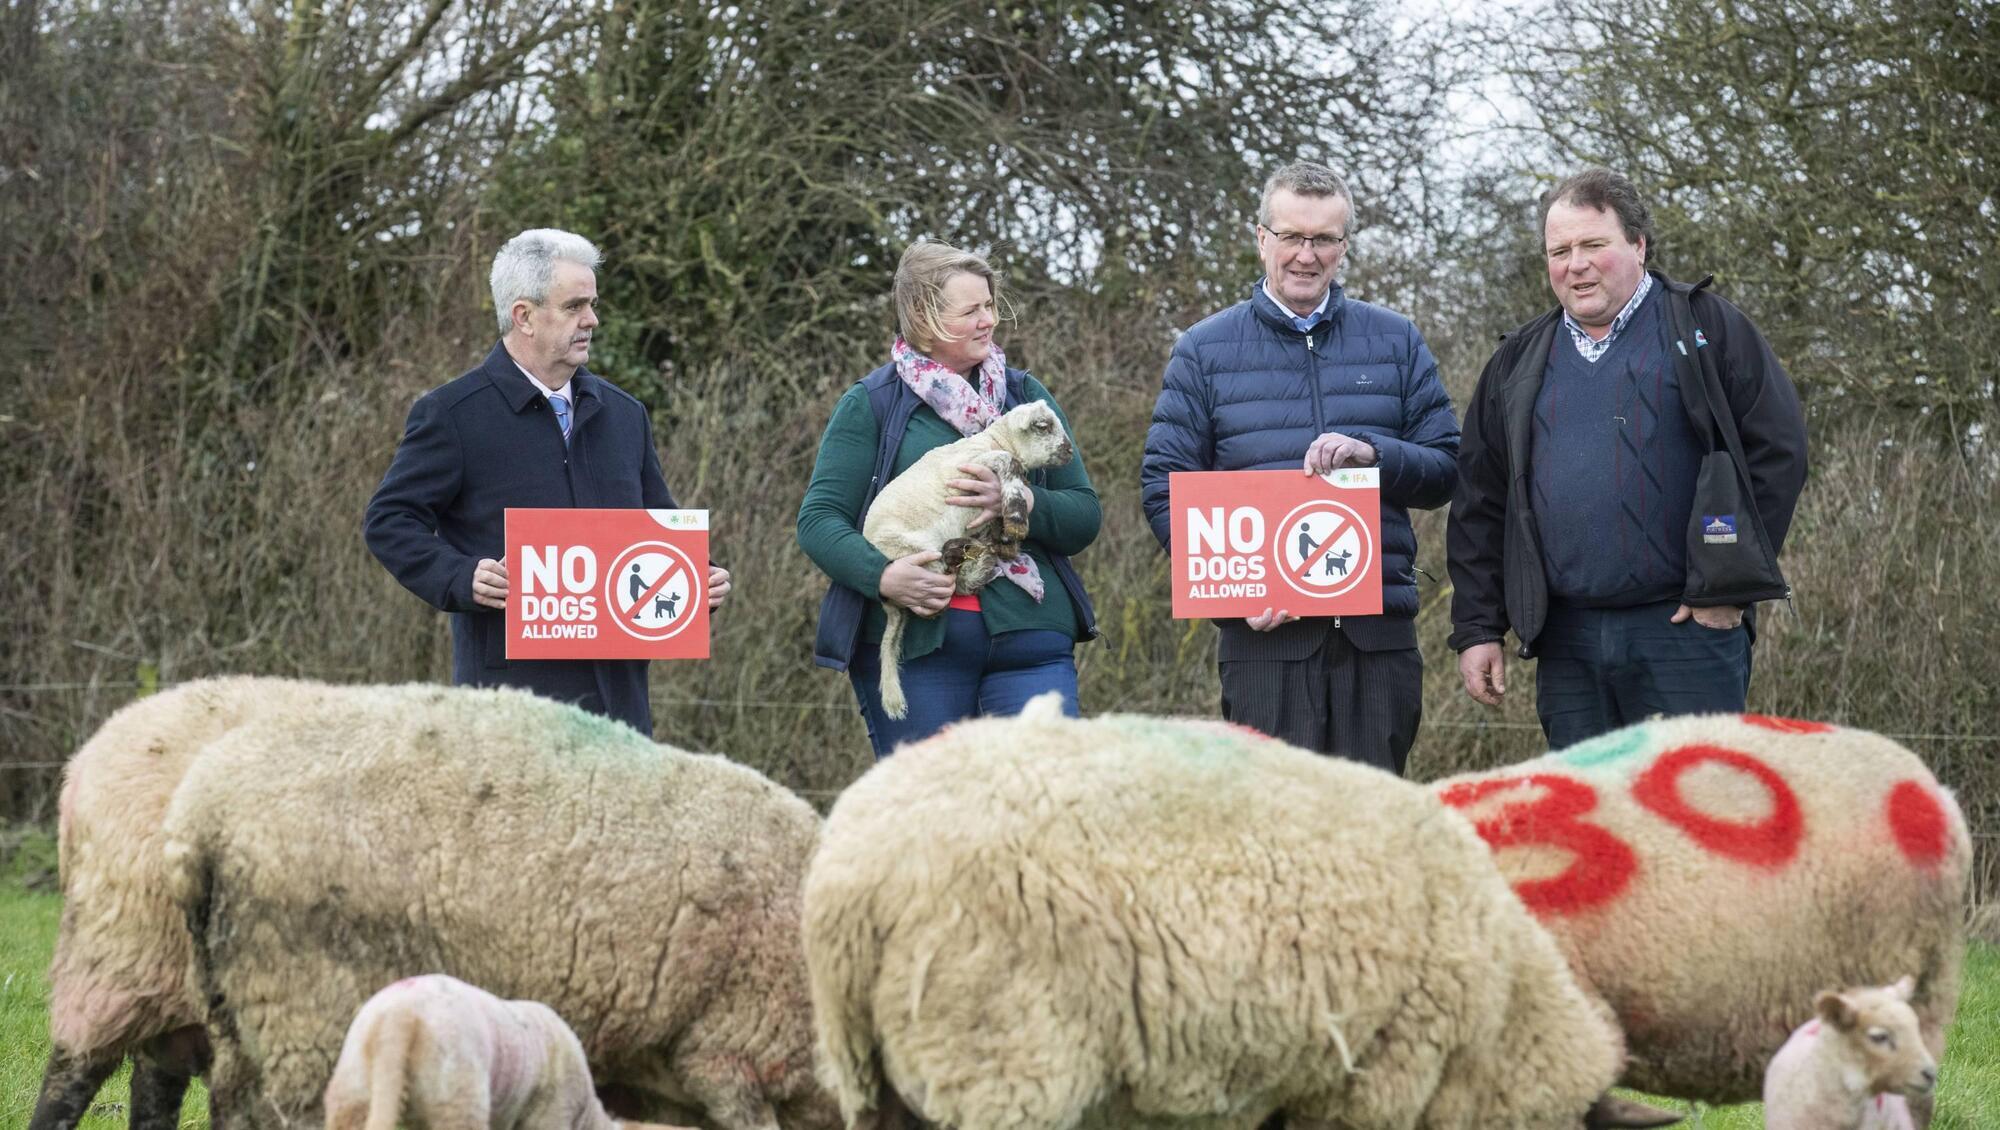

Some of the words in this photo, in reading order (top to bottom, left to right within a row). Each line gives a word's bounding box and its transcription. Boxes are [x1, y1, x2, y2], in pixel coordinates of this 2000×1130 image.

[1353, 473, 1368, 483] IFA
[683, 515, 698, 525] IFA
[1187, 506, 1265, 554] NO
[521, 545, 597, 594] NO
[1188, 555, 1266, 581] DOGS
[1189, 583, 1267, 599] ALLOWED
[521, 595, 597, 621] DOGS
[521, 624, 598, 639] ALLOWED
